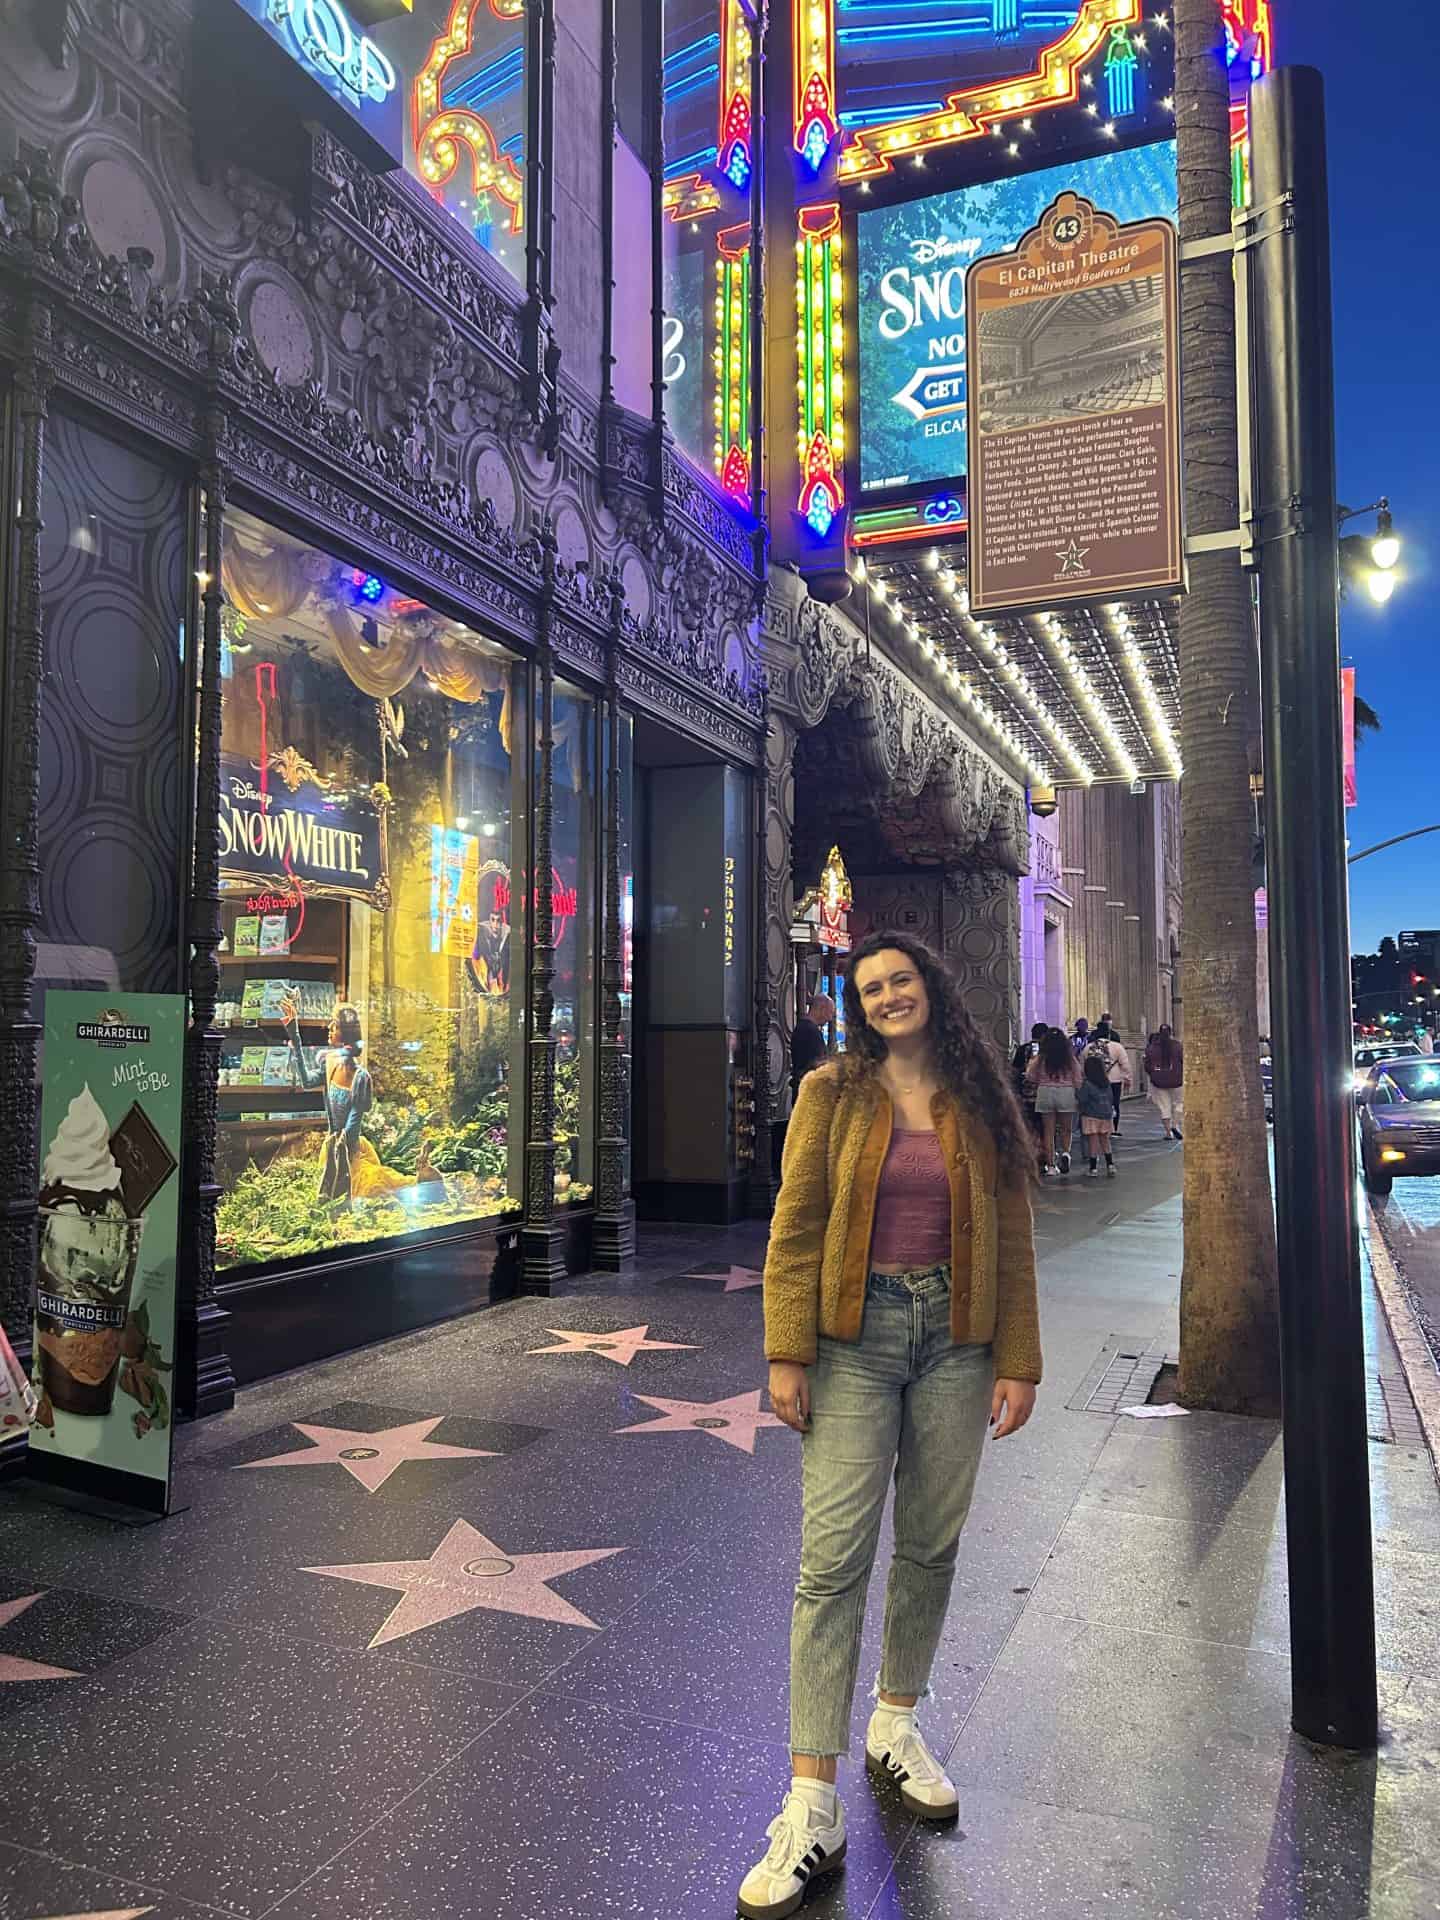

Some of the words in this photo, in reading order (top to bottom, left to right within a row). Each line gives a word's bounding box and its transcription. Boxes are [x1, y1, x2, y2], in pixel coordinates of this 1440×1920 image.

[1055, 219, 1078, 238] 43
[909, 236, 981, 264] Disney
[1000, 271, 1012, 285] El
[1018, 258, 1075, 281] Capitan
[1080, 244, 1140, 266] Theatre
[1031, 274, 1081, 296] Hollywood
[1082, 264, 1131, 282] Boulevard
[879, 266, 966, 339] SNO
[924, 378, 963, 400] GET
[229, 776, 273, 810] Disney
[282, 808, 369, 880] WHITE
[79, 1025, 148, 1041] GHIRARDELLI
[111, 1057, 148, 1087] Mint
[136, 1079, 149, 1093] to
[148, 1071, 170, 1092] Be
[39, 1296, 120, 1323] GHIRARDELLI
